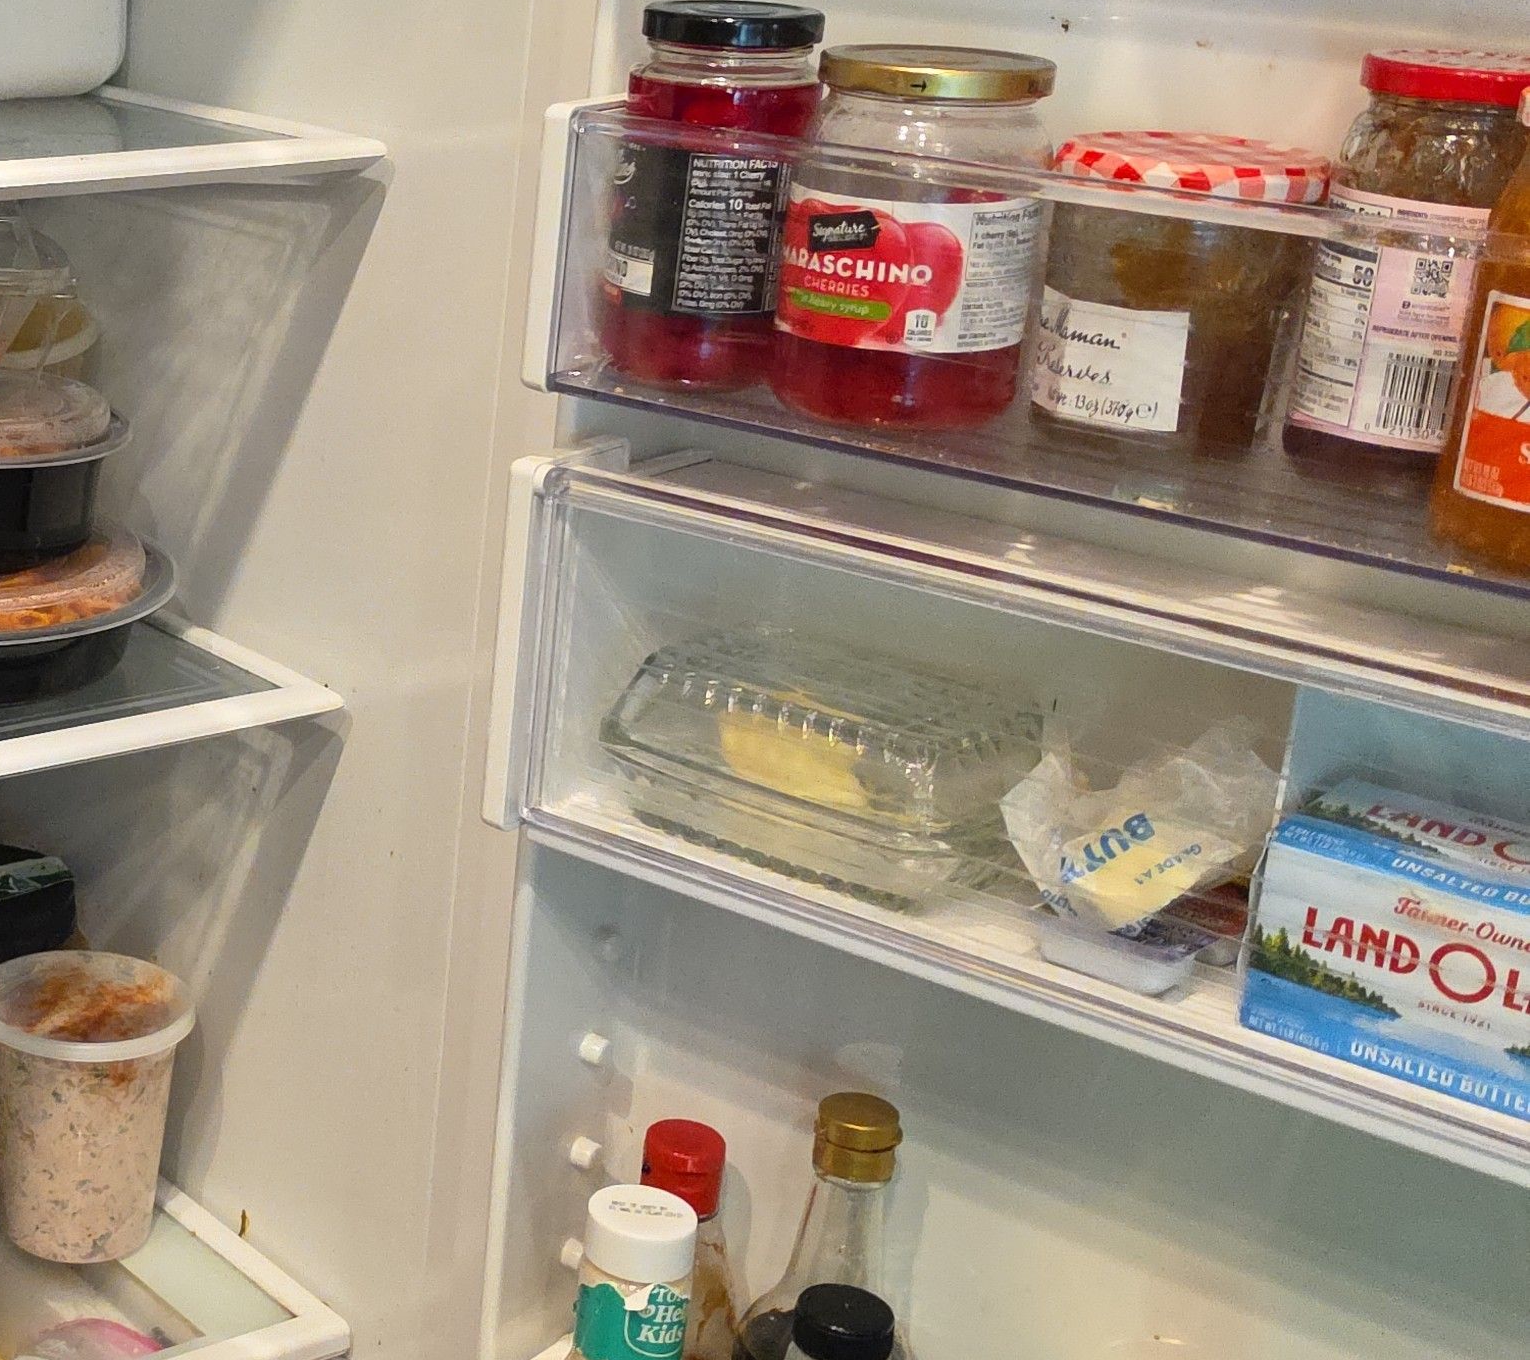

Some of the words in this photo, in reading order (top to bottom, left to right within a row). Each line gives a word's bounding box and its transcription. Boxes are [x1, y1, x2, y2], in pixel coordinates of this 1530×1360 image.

[693, 159, 748, 170] NUTRITION
[688, 200, 726, 210] Calories
[728, 198, 743, 211] 10
[812, 220, 866, 242] Signature
[803, 275, 870, 297] CHERRIES
[1352, 264, 1375, 287] 50
[839, 302, 870, 316] syrup
[915, 314, 930, 329] 10
[1365, 804, 1488, 848] LAND
[1391, 857, 1499, 898] UNSALTED
[1301, 905, 1421, 976] LAND
[1427, 941, 1498, 1005] O
[1417, 1000, 1457, 1021] SINCE
[1350, 1039, 1454, 1088] UNSALTED
[1459, 1076, 1530, 1114] BUTTE
